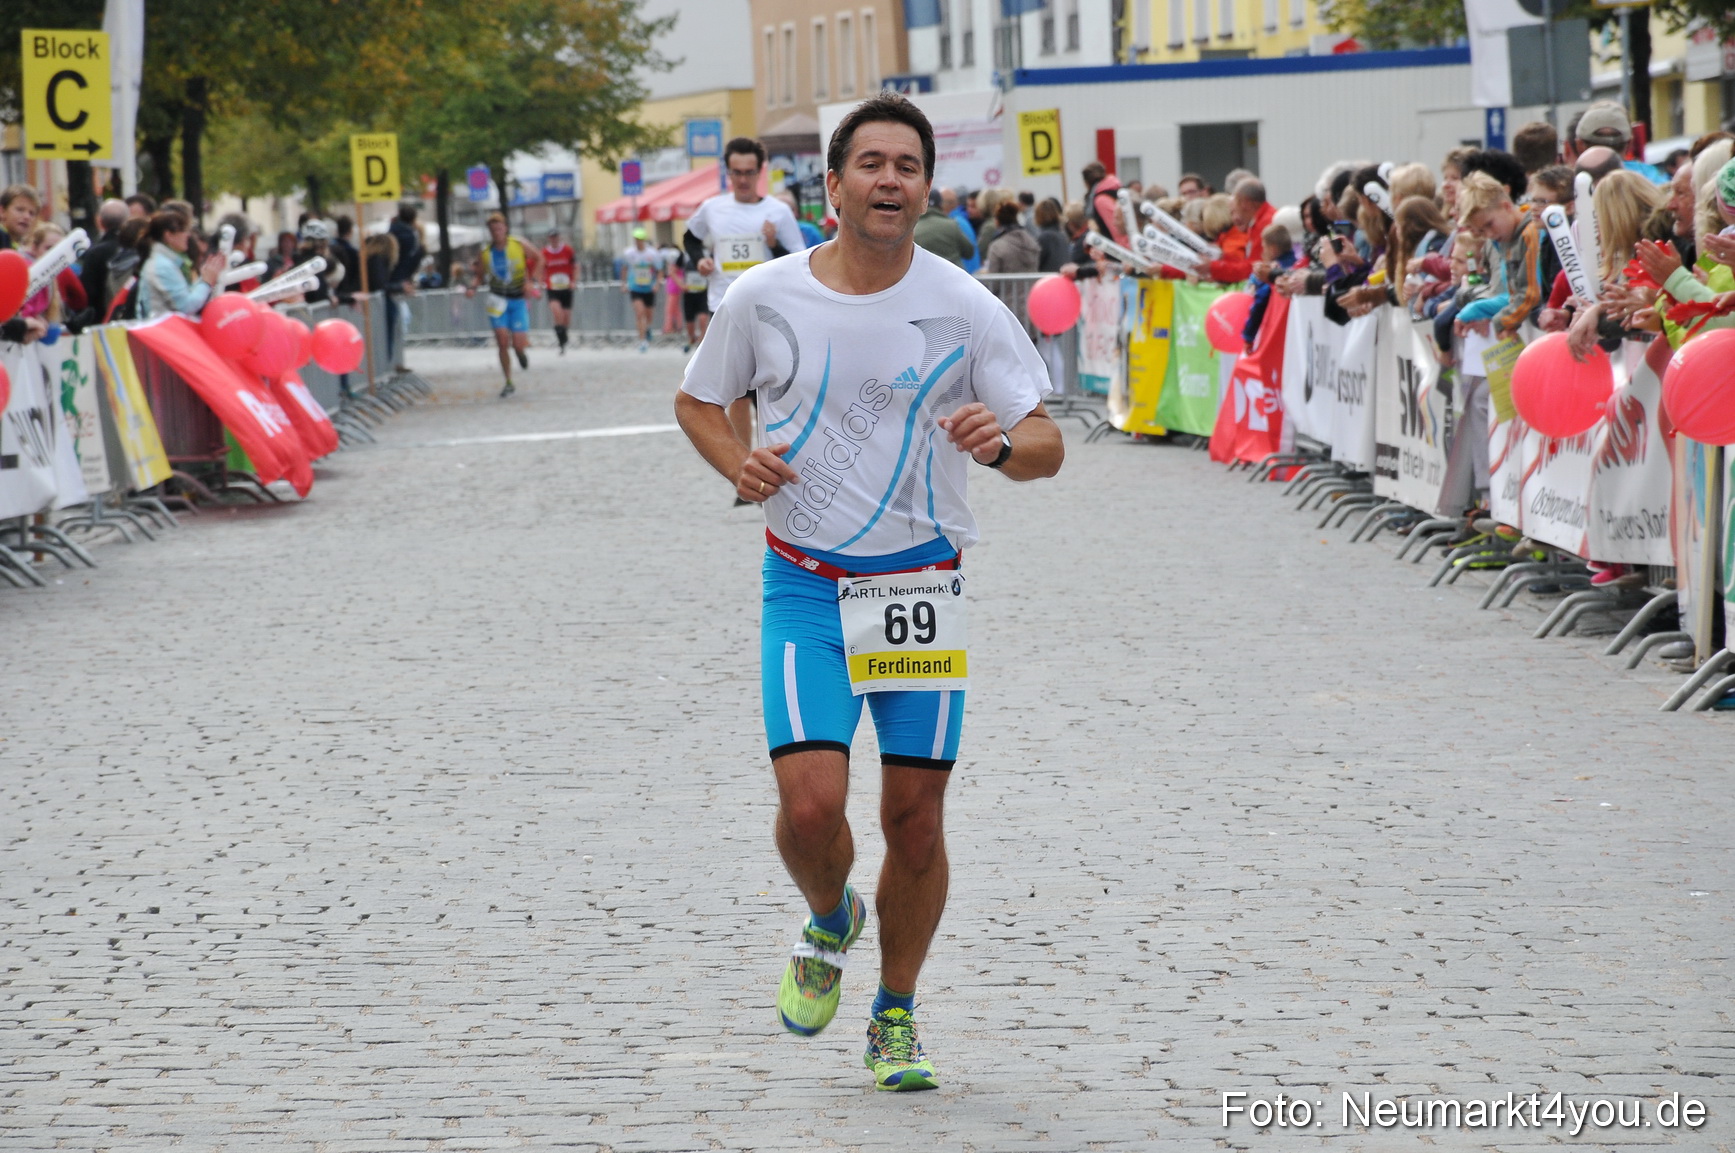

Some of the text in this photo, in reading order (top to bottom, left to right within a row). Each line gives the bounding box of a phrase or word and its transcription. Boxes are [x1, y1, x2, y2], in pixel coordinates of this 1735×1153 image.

[33, 36, 100, 59] Block
[46, 69, 89, 132] C
[1021, 111, 1056, 126] Block
[357, 138, 390, 150] Block
[1031, 130, 1052, 161] D
[365, 155, 387, 186] D
[732, 243, 750, 260] 53
[1556, 235, 1582, 274] BMW
[890, 381, 923, 390] adidas
[786, 379, 894, 538] adidas
[780, 550, 798, 563] balance
[850, 582, 949, 599] ARTL Neumarkt
[884, 601, 936, 645] 69
[868, 656, 952, 675] Ferdinand
